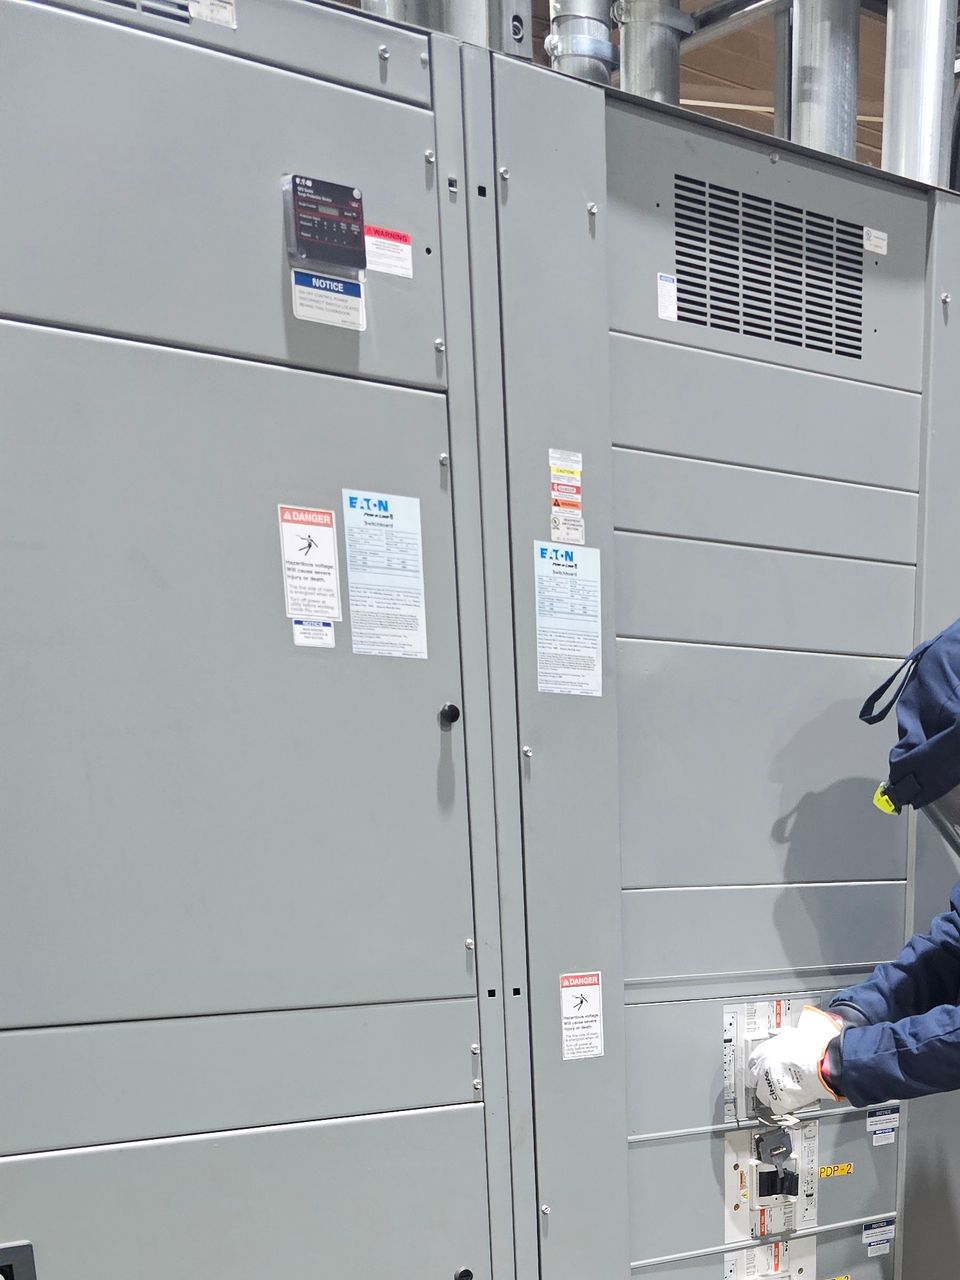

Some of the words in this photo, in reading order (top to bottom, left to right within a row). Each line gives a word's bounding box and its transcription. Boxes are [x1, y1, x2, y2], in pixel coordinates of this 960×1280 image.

[373, 228, 408, 243] WARNING
[312, 277, 344, 292] NOTICE
[349, 496, 389, 512] EATON
[292, 511, 331, 525] DANGER
[540, 547, 574, 562] EATON
[569, 976, 598, 986] DANGER
[820, 1163, 852, 1178] PDP-2
